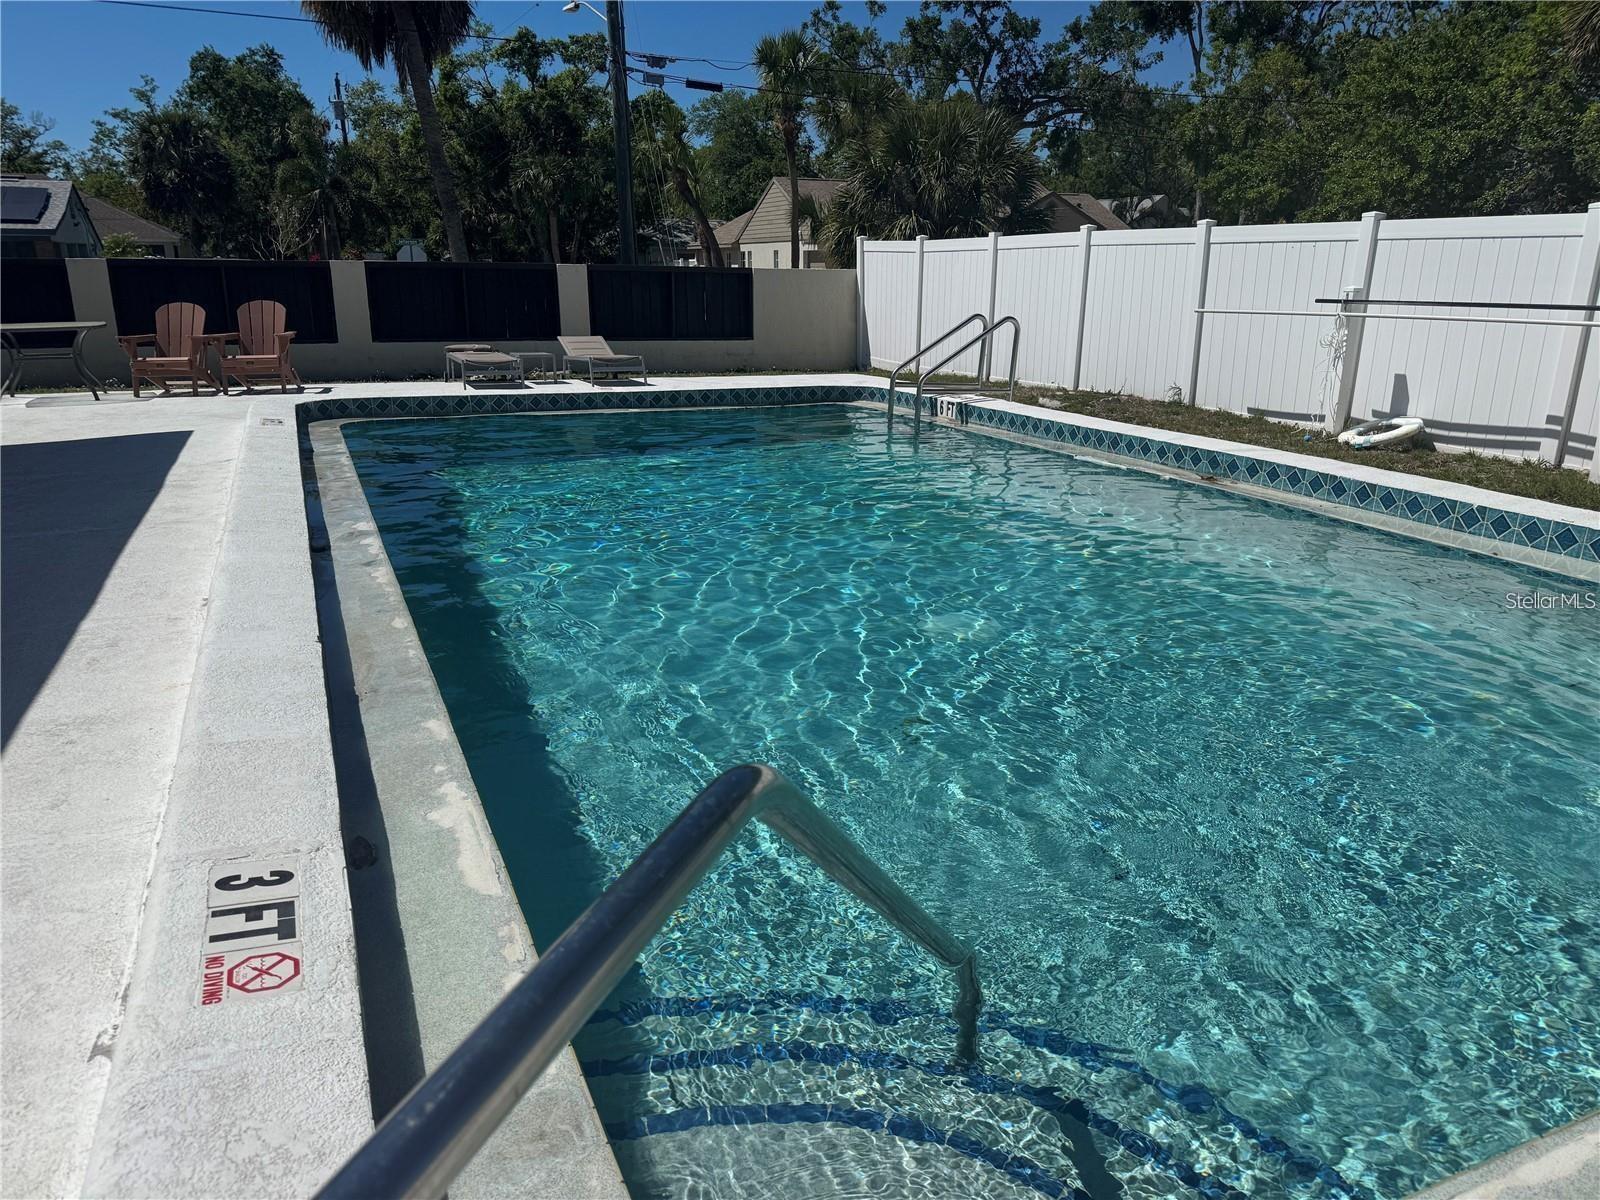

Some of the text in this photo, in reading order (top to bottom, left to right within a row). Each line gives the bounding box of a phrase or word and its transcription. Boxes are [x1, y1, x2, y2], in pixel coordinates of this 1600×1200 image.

[939, 400, 956, 418] 6 FT
[208, 870, 297, 943] 3 FT
[202, 955, 225, 1006] NO DIVING
